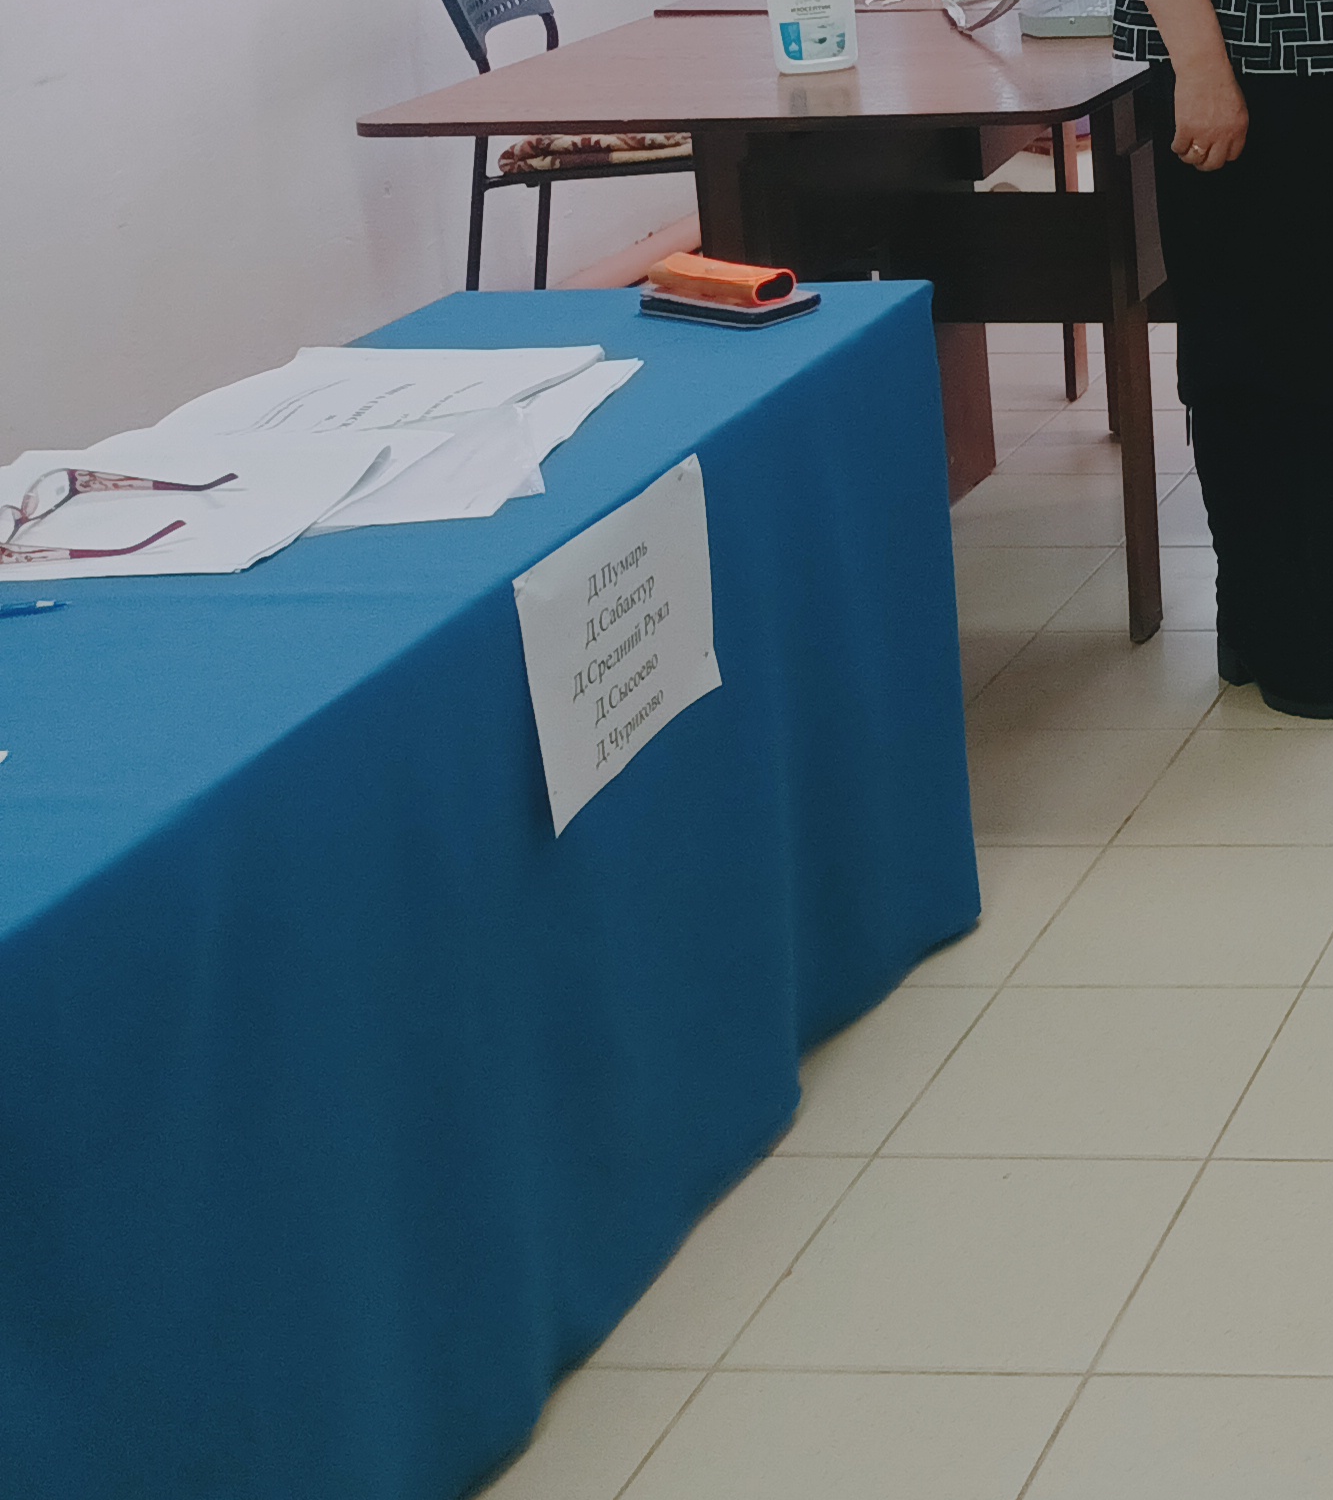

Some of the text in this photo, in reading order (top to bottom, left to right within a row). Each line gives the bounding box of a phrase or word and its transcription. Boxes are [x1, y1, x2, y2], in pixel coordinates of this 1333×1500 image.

[588, 541, 648, 606] Д.Пумарь
[585, 575, 655, 650] Д.Сабактур
[573, 623, 642, 704] Д.Средний
